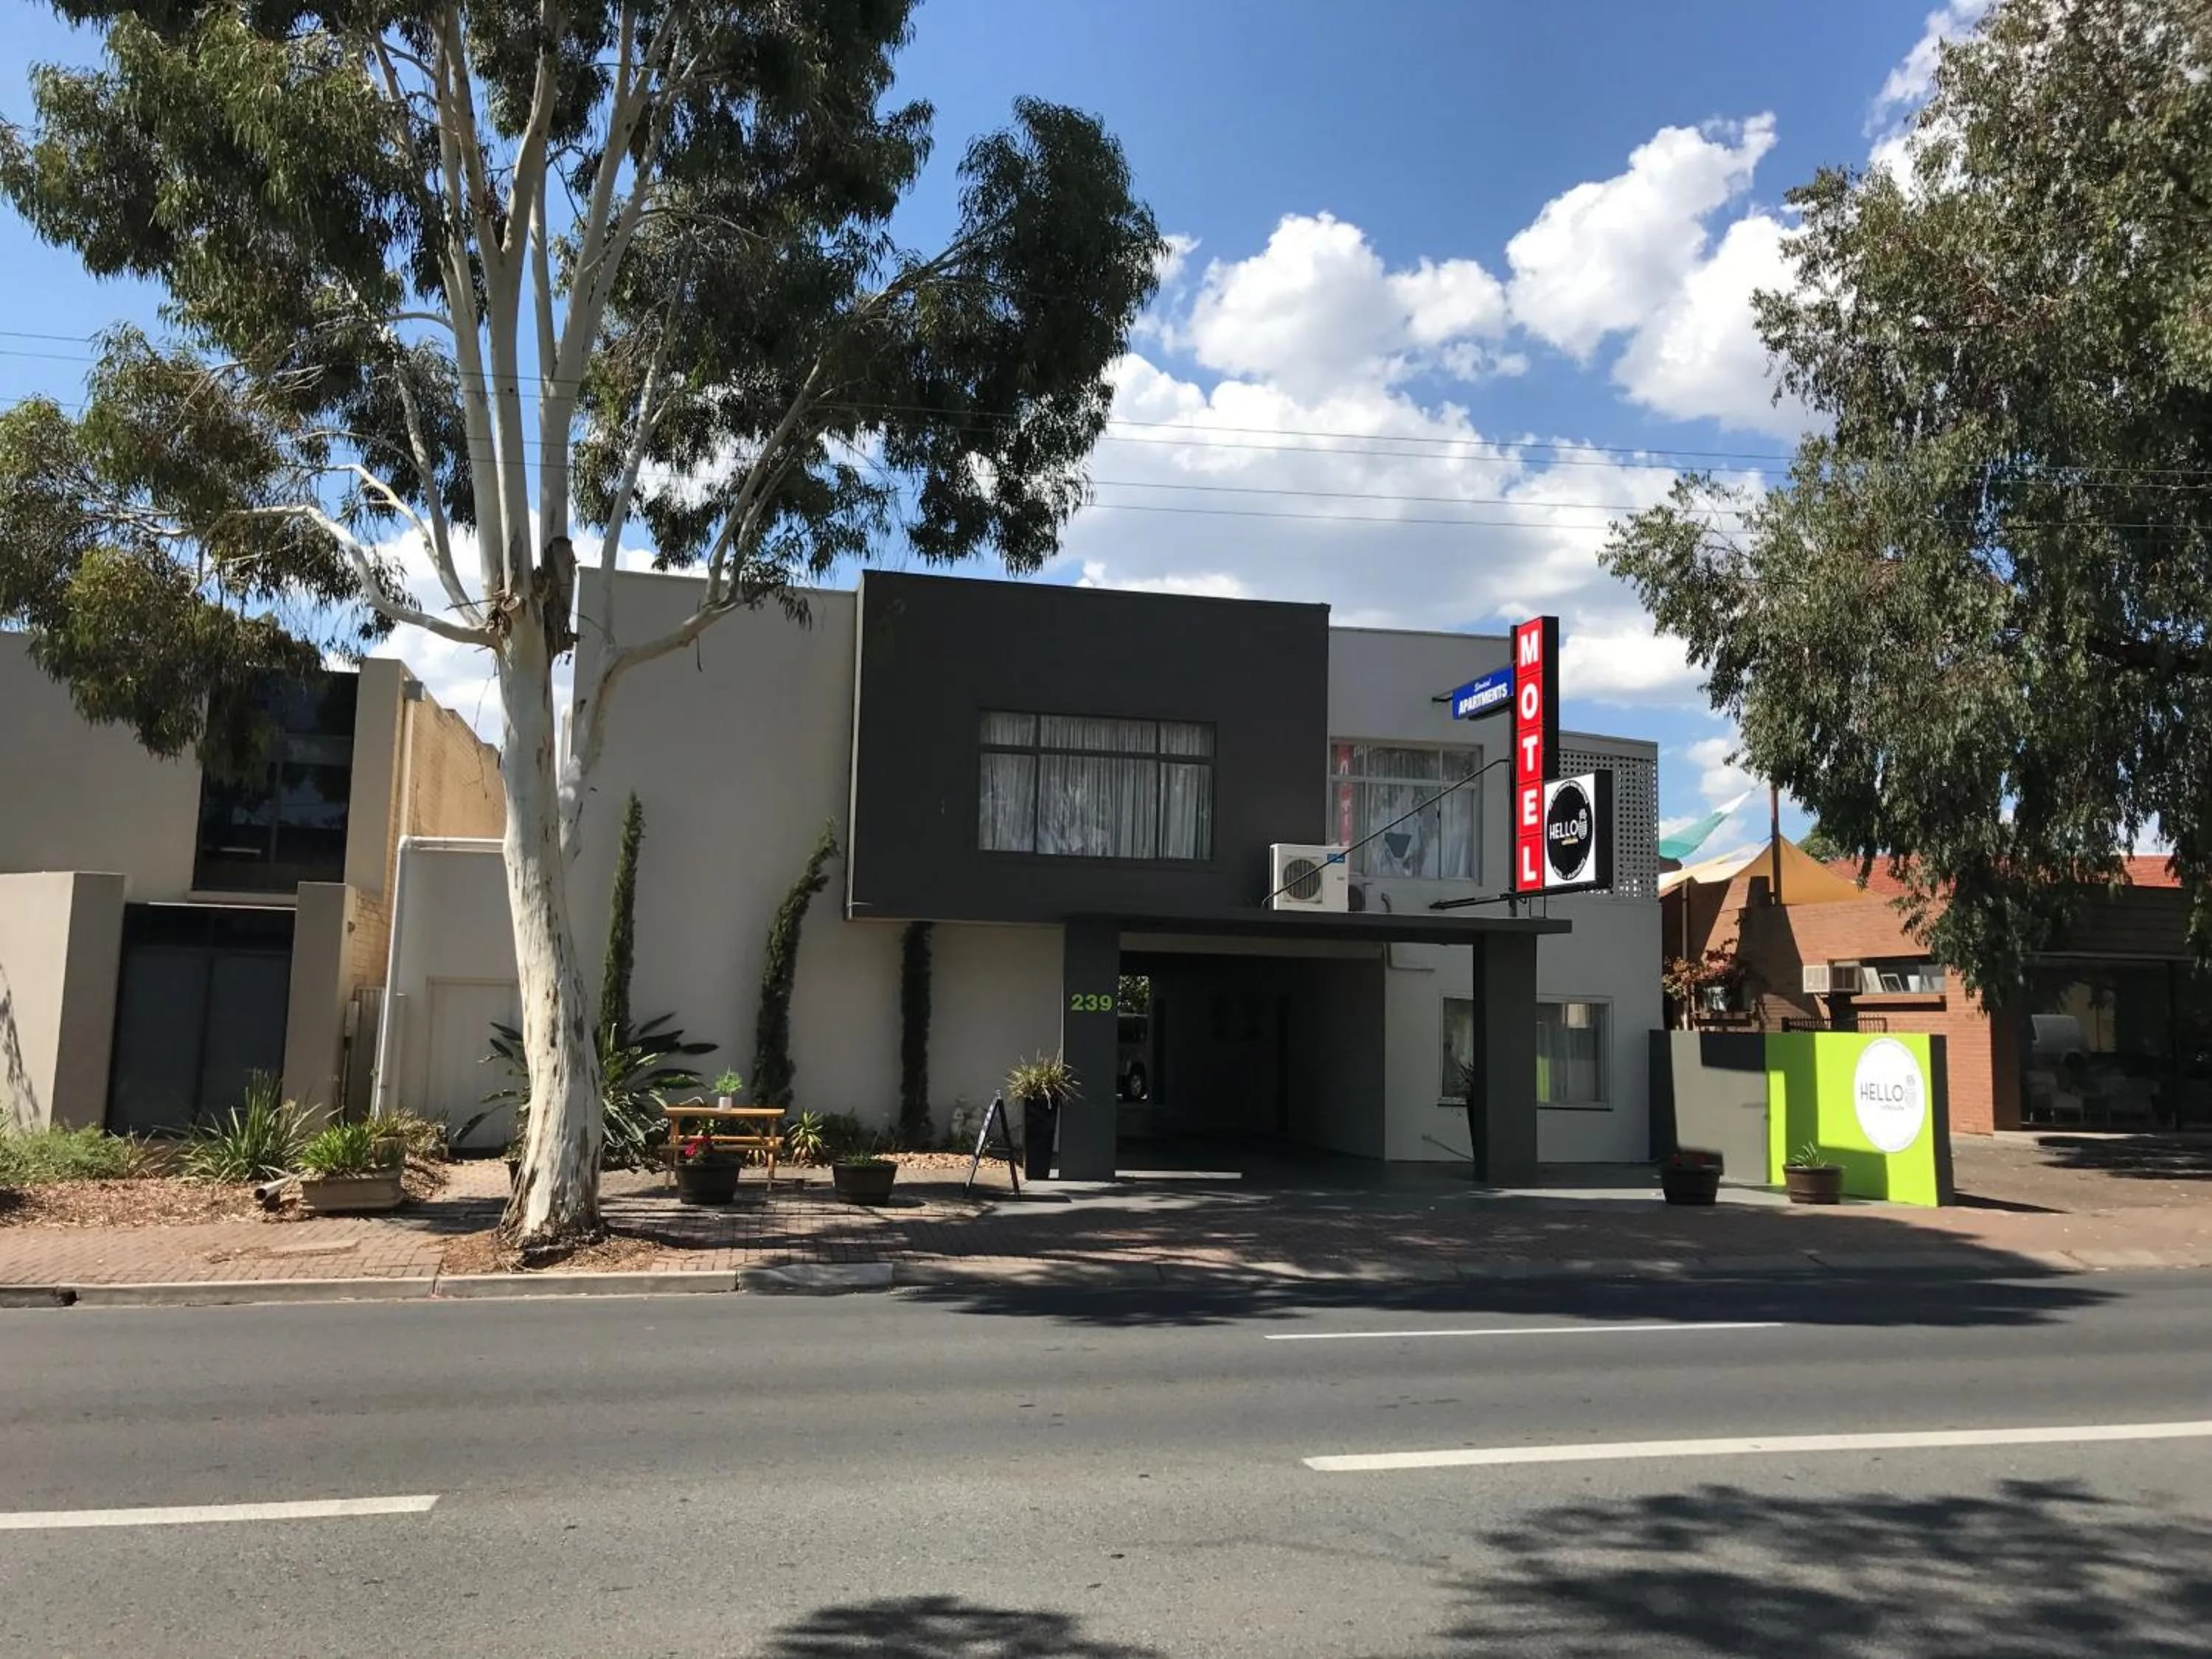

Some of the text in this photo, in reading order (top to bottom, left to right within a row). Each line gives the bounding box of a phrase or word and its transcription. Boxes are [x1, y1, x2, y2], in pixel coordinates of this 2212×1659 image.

[1458, 682, 1508, 715] APARTMENTS
[1520, 629, 1540, 881] MOTEL
[1549, 819, 1579, 840] HELLO
[1071, 993, 1113, 1011] 239
[1860, 1082, 1904, 1102] HELLO
